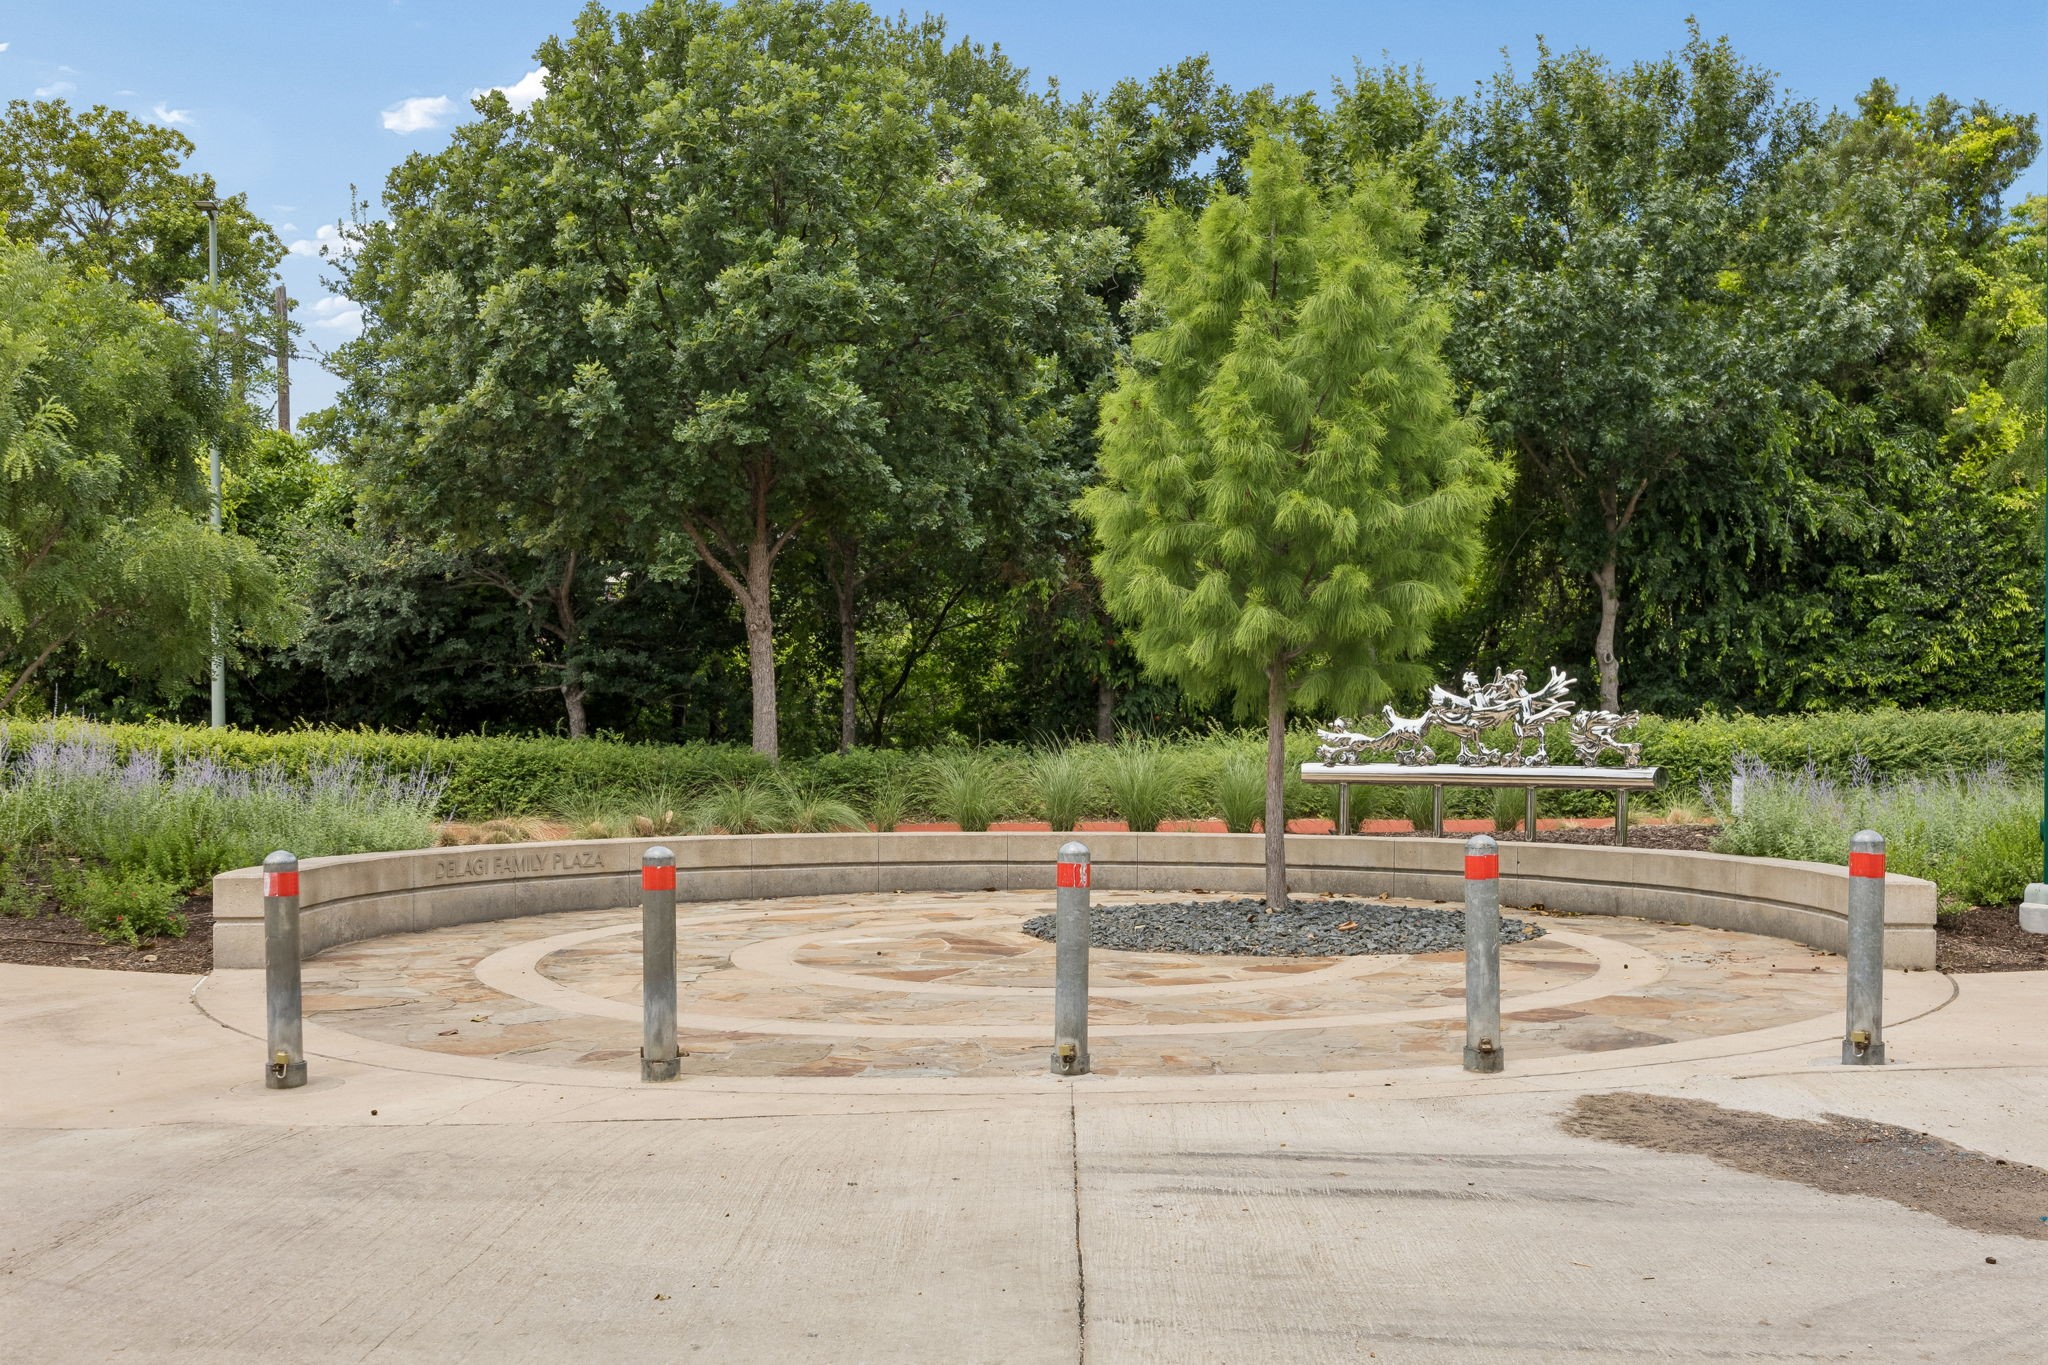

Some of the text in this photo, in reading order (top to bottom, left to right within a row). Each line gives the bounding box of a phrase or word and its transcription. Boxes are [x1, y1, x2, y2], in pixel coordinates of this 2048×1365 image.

[435, 852, 604, 879] DELAGI FAMILY PLAZA
